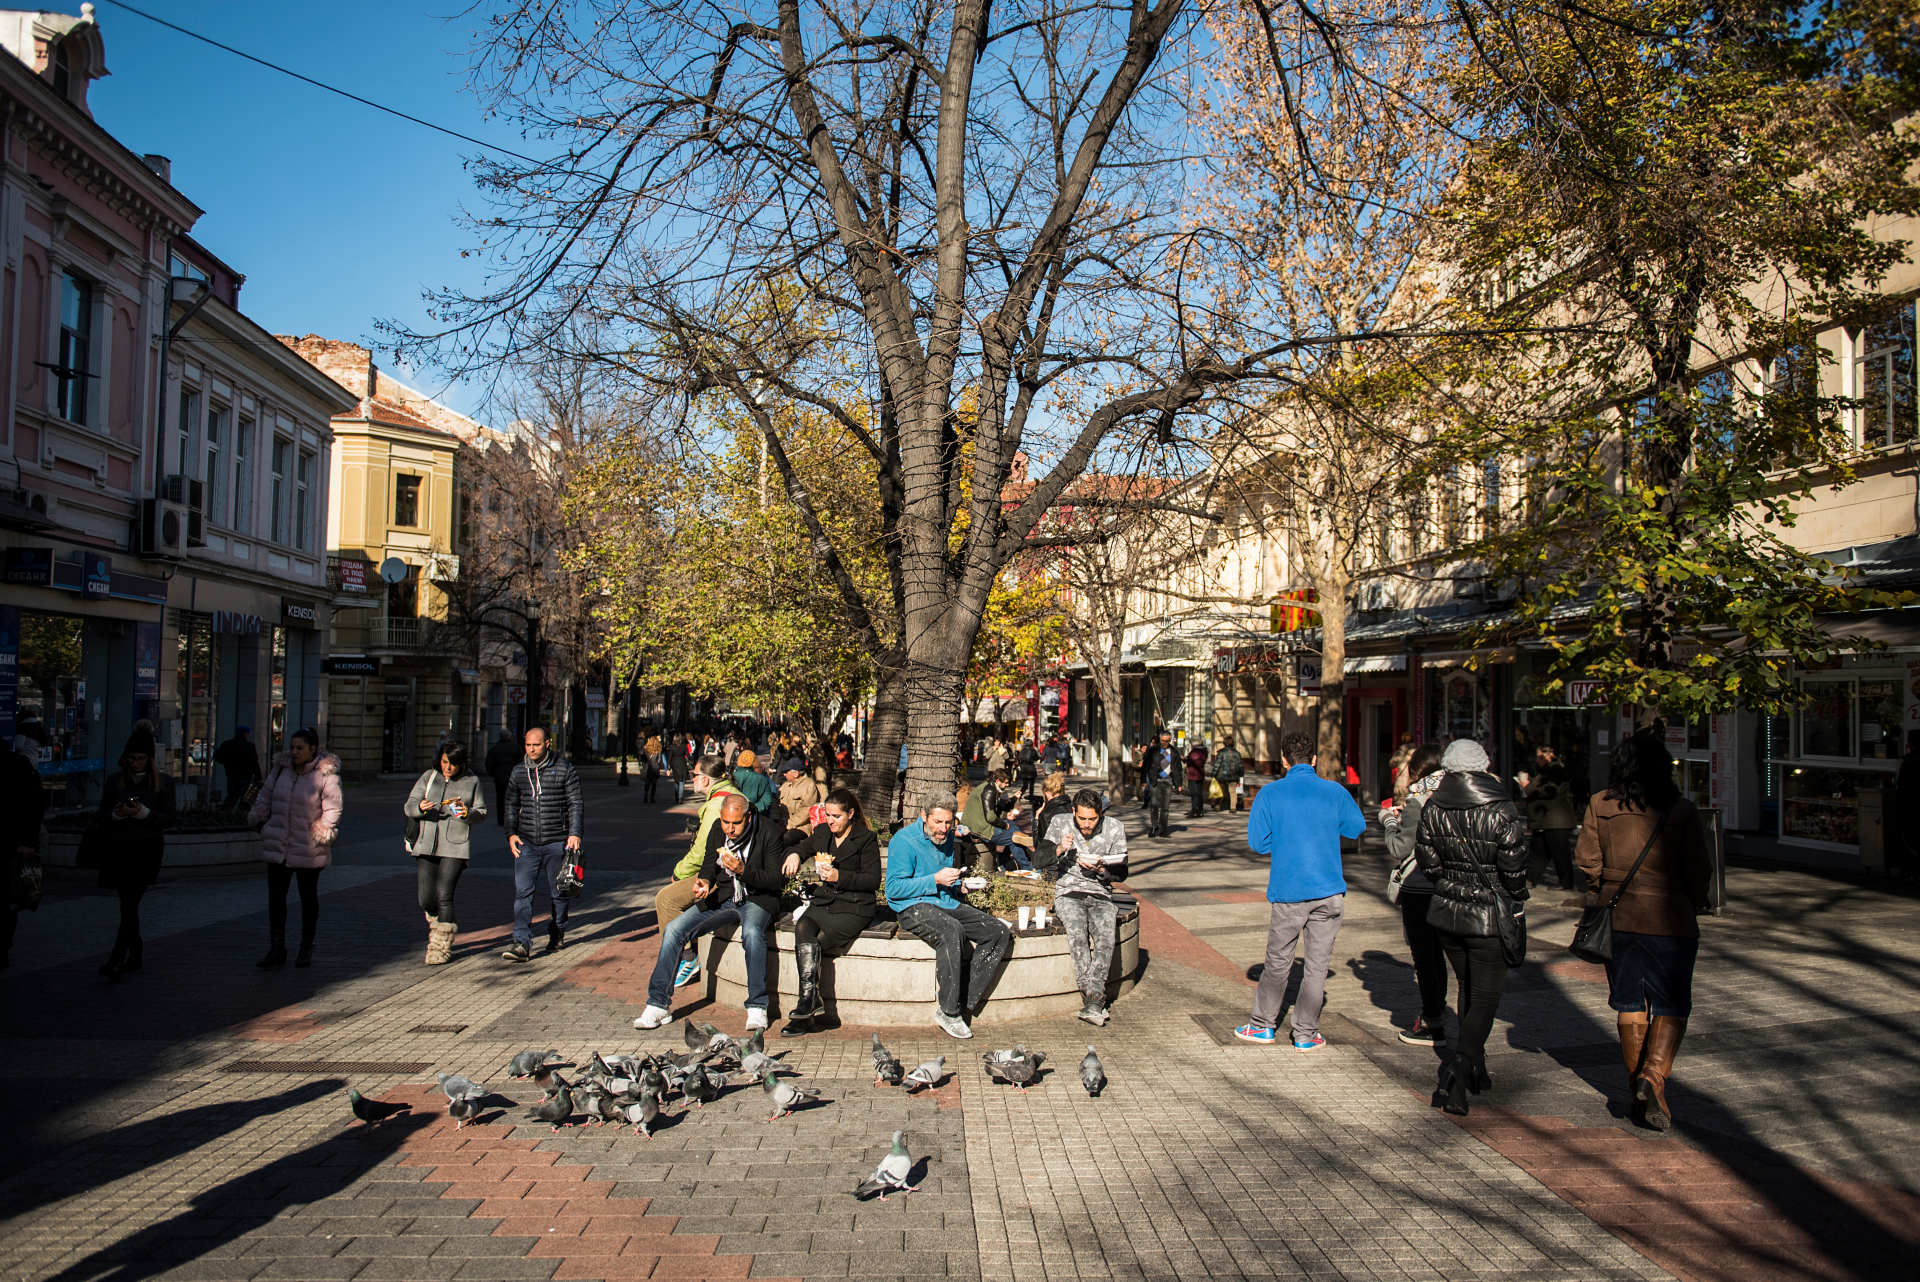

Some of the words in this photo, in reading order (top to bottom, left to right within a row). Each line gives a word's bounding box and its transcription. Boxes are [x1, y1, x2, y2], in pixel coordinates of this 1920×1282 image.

[342, 561, 364, 570] ОТДАВА
[7, 571, 47, 582] СИБАНК
[351, 570, 364, 578] ПОД
[88, 581, 110, 595] СИБАНК
[287, 604, 317, 620] KENSOL
[213, 610, 262, 636] INDIGO
[1907, 660, 1920, 669] ША
[138, 668, 156, 678] СИБАНК
